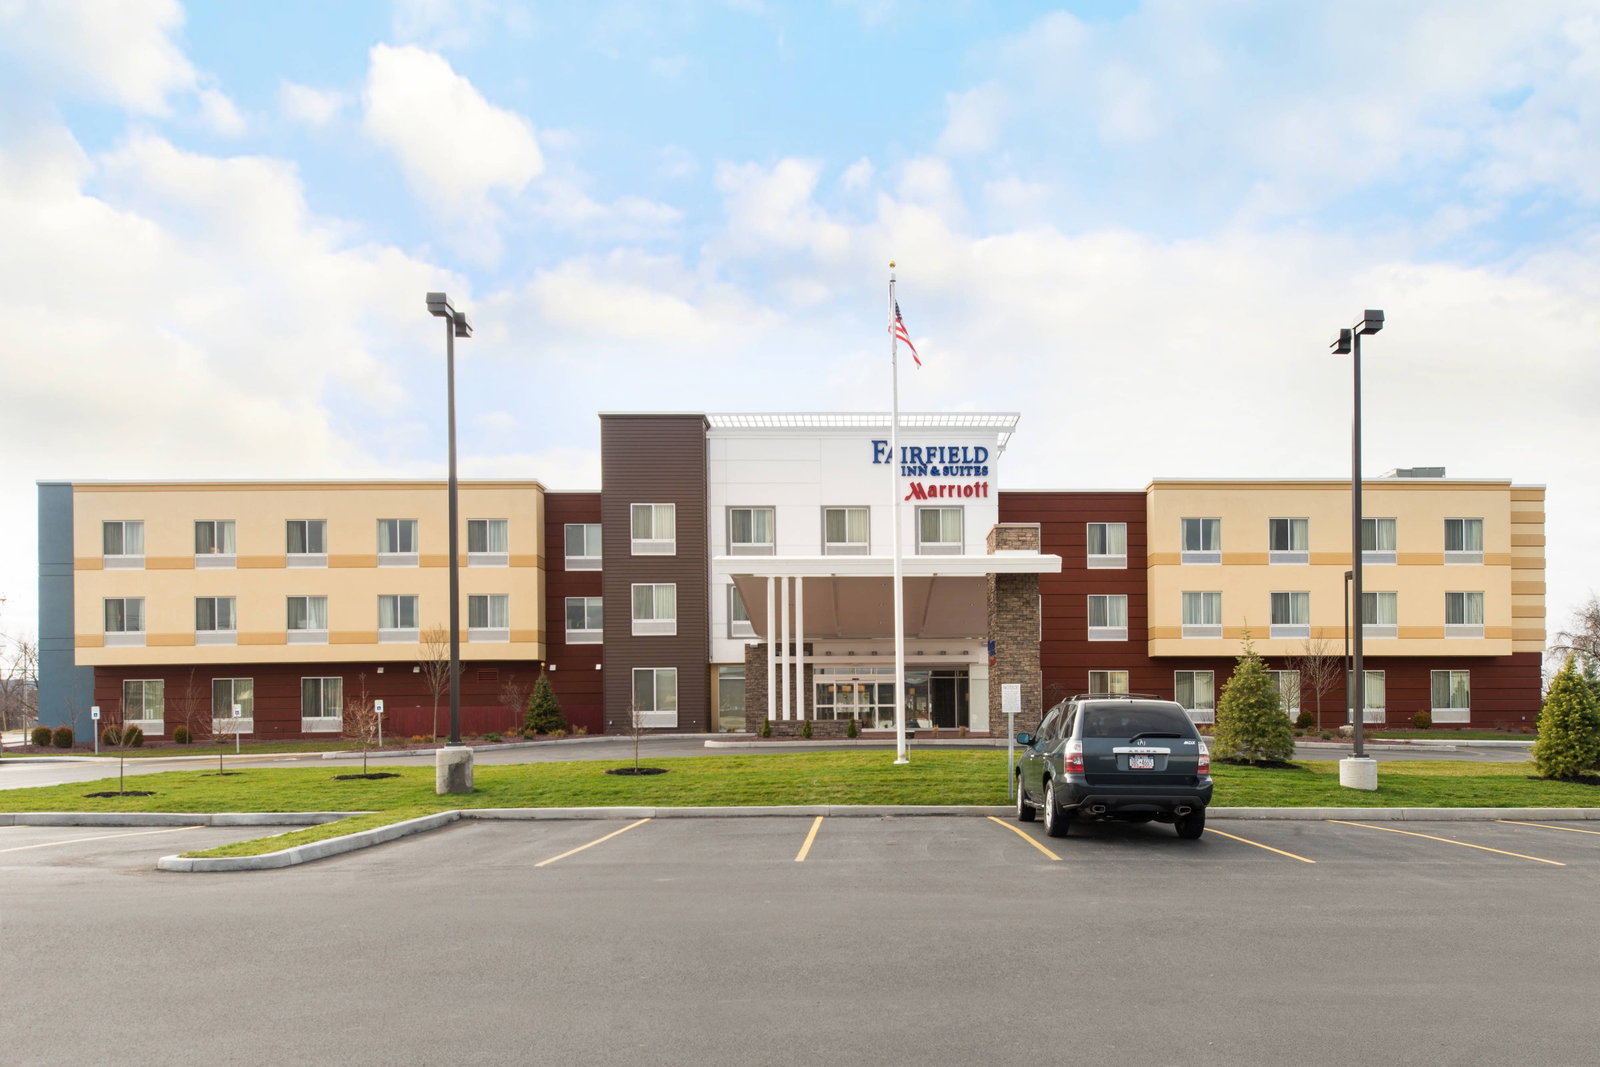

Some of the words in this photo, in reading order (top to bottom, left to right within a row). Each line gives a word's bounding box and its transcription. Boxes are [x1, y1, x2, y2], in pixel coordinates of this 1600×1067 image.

[901, 466, 928, 476] INN
[930, 466, 940, 476] &
[943, 466, 989, 476] SUITES
[904, 481, 989, 501] Marriott
